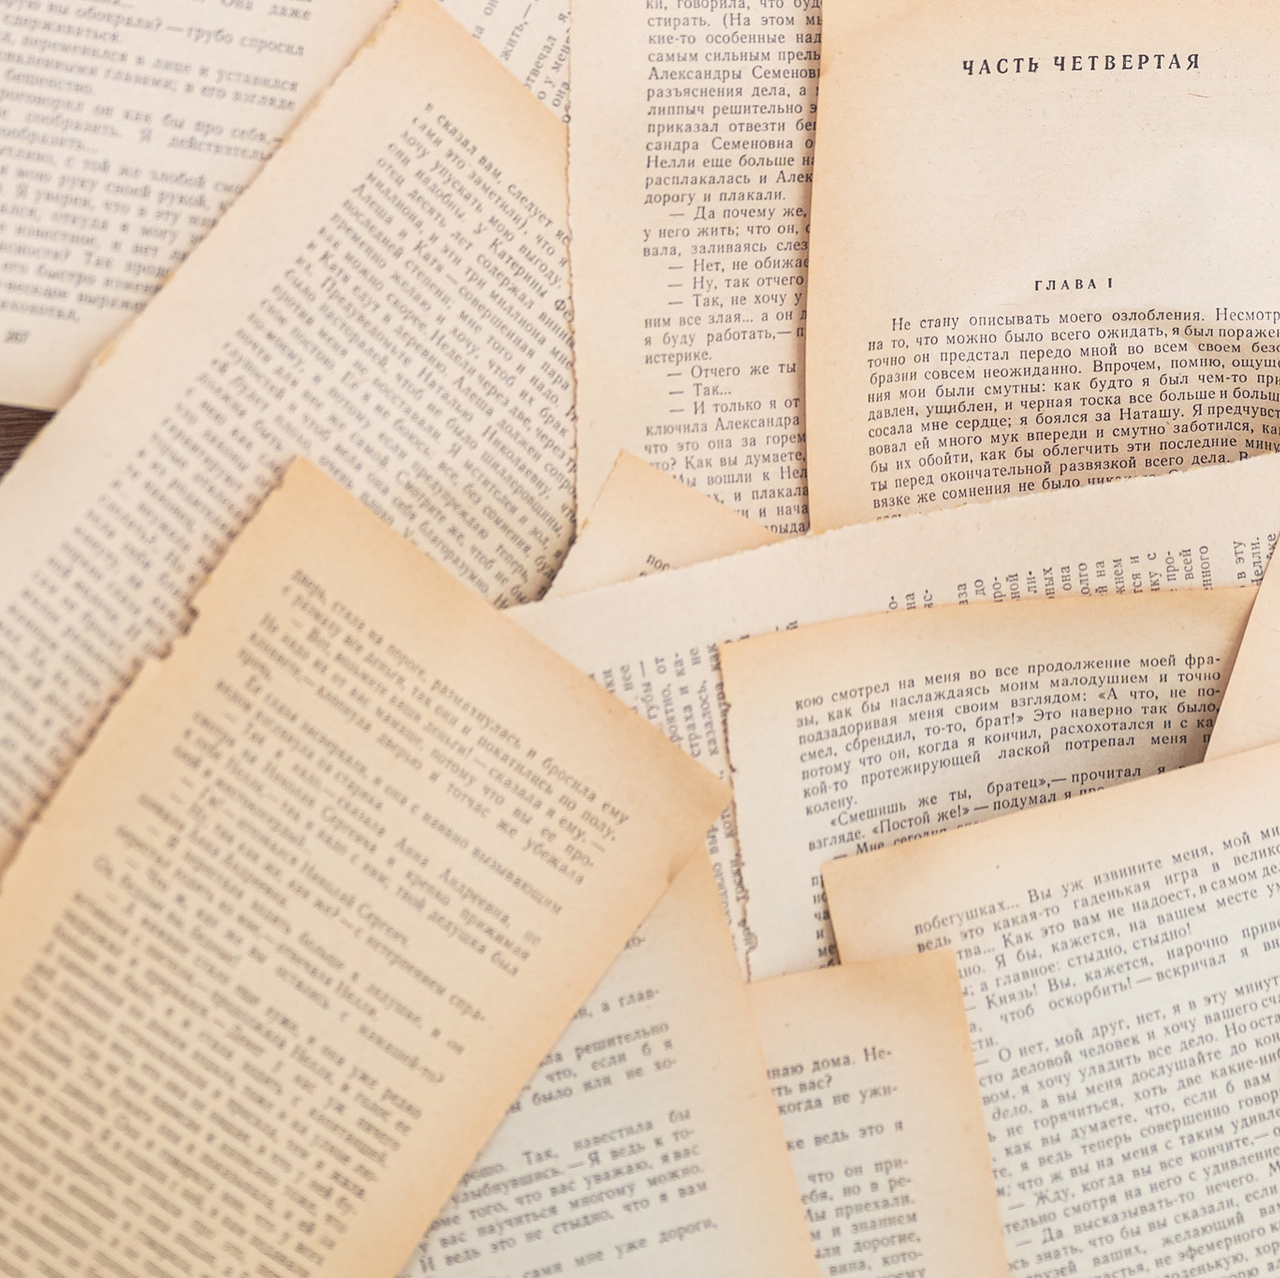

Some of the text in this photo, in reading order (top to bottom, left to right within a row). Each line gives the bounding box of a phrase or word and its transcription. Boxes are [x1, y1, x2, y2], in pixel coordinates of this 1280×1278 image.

[962, 53, 1198, 75] ЧАСТЬ ЧЕТВЕРТАЯ
[1034, 277, 1112, 291] ГЛАВА I
[891, 316, 910, 331] Не
[919, 316, 959, 330] стану
[968, 314, 1049, 326] описывать
[1058, 312, 1102, 323] моего
[1111, 308, 1204, 321] озлобления.
[867, 340, 883, 351] на
[890, 338, 908, 349] то,
[915, 335, 938, 346] что
[946, 333, 996, 344] можно
[1004, 329, 1043, 342] было
[1050, 329, 1090, 341] всего
[1097, 326, 1167, 339] ожидать,
[1171, 326, 1179, 335] я
[1184, 324, 1213, 336] был
[866, 355, 905, 368] точно
[913, 352, 929, 363] он
[940, 350, 1008, 365] предстал
[1019, 347, 1071, 362] передо
[1080, 342, 1117, 356] мной
[1127, 344, 1144, 354] во
[1153, 342, 1187, 353] всем
[1197, 342, 1240, 352] своем
[794, 653, 1220, 710] кою смотрел на меня во все продолжение моей фра-
[914, 900, 1018, 935] побегушках...
[1093, 858, 1162, 885] извините
[1171, 845, 1213, 864] меня,
[1222, 830, 1250, 850] мой
